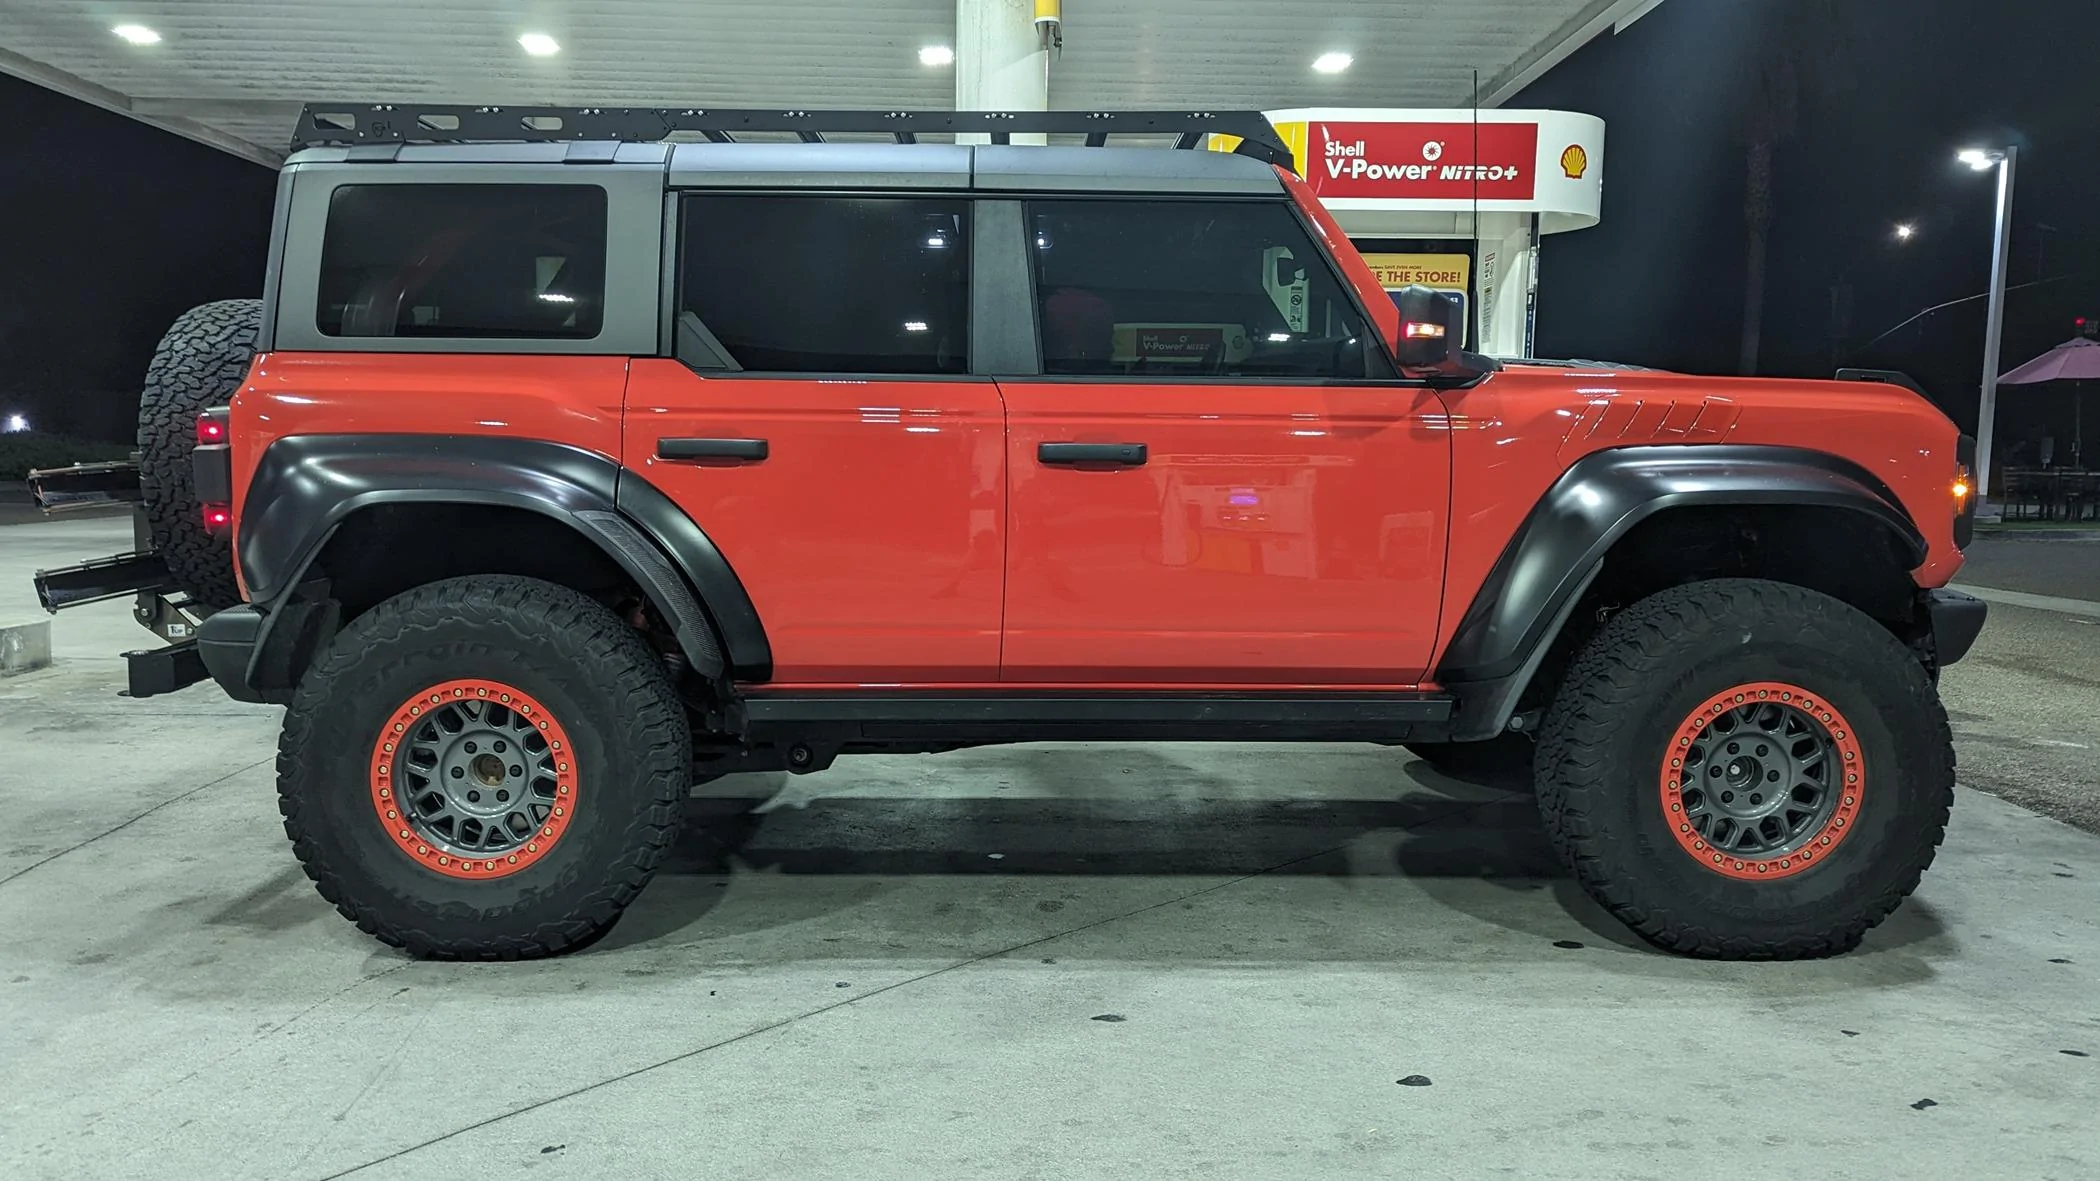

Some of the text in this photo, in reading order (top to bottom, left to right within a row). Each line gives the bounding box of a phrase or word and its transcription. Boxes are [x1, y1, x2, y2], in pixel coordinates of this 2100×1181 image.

[1324, 140, 1365, 157] Shell
[1324, 158, 1433, 180] V-Power
[1387, 270, 1411, 282] THE
[1415, 271, 1461, 283] STORE!
